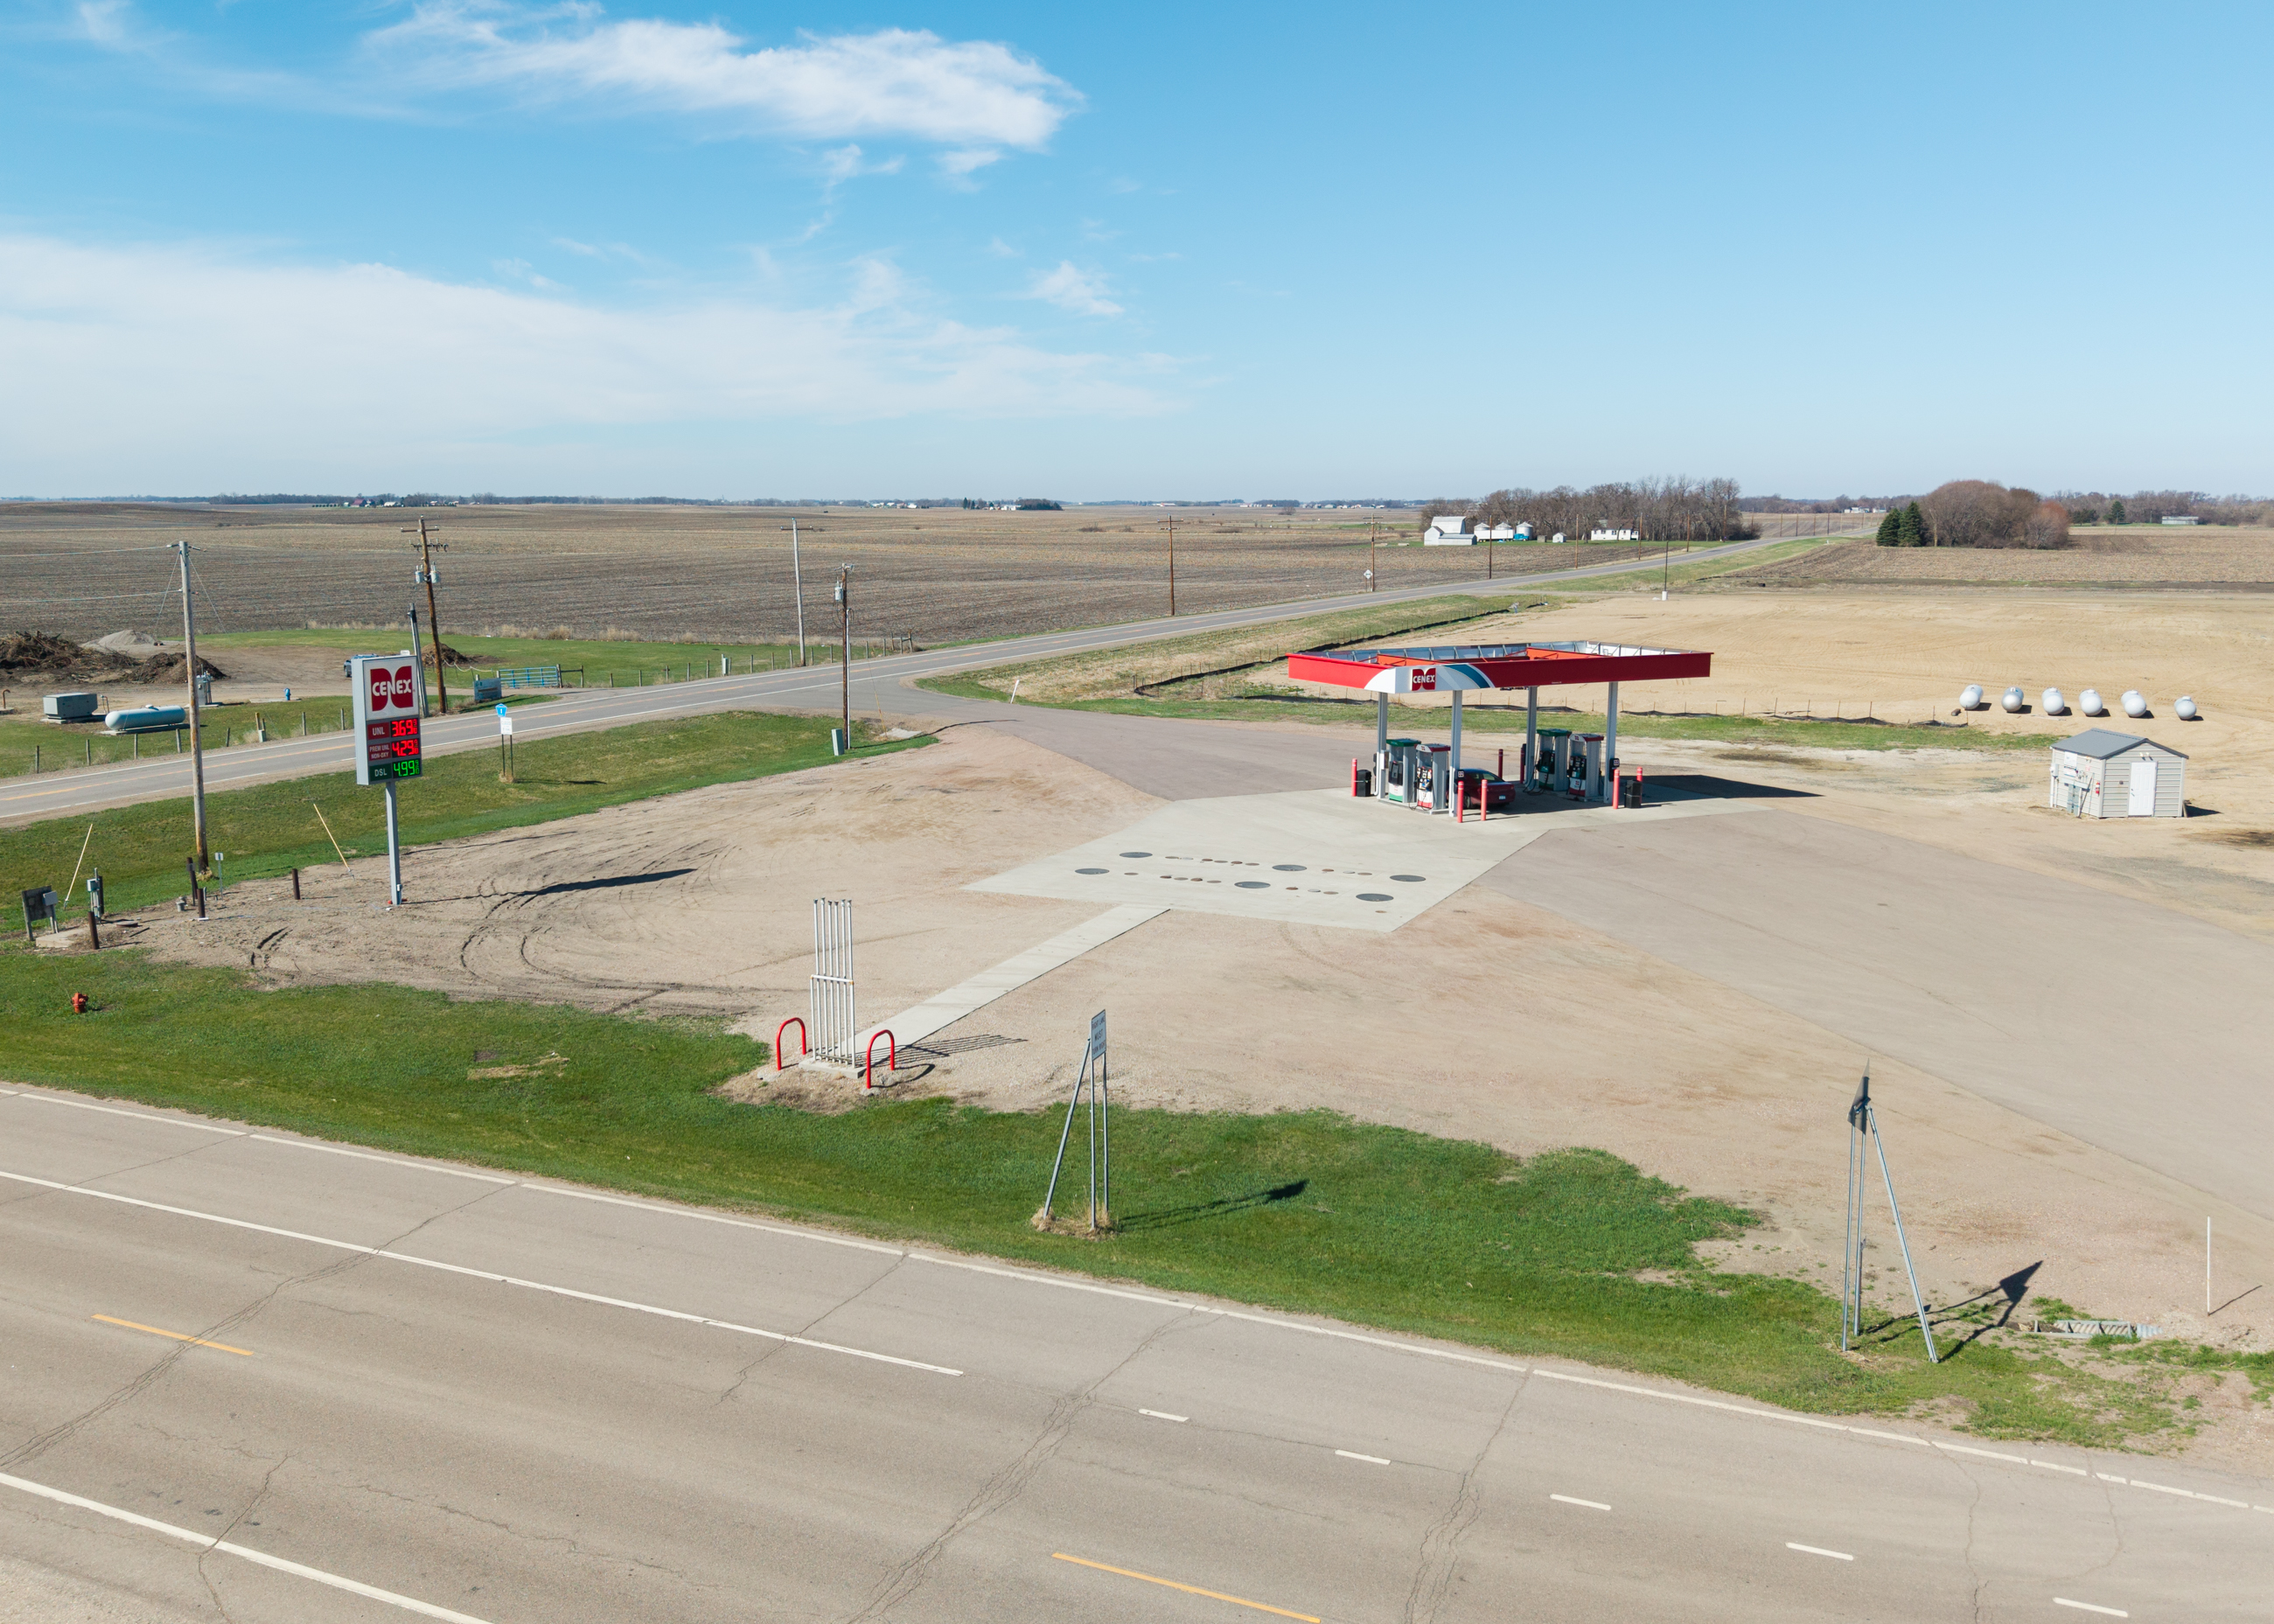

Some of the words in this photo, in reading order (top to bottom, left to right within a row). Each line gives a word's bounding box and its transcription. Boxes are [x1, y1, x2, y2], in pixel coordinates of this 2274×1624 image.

[1413, 674, 1435, 684] CENEX
[372, 679, 412, 697] CENEX
[372, 727, 385, 736] UNL
